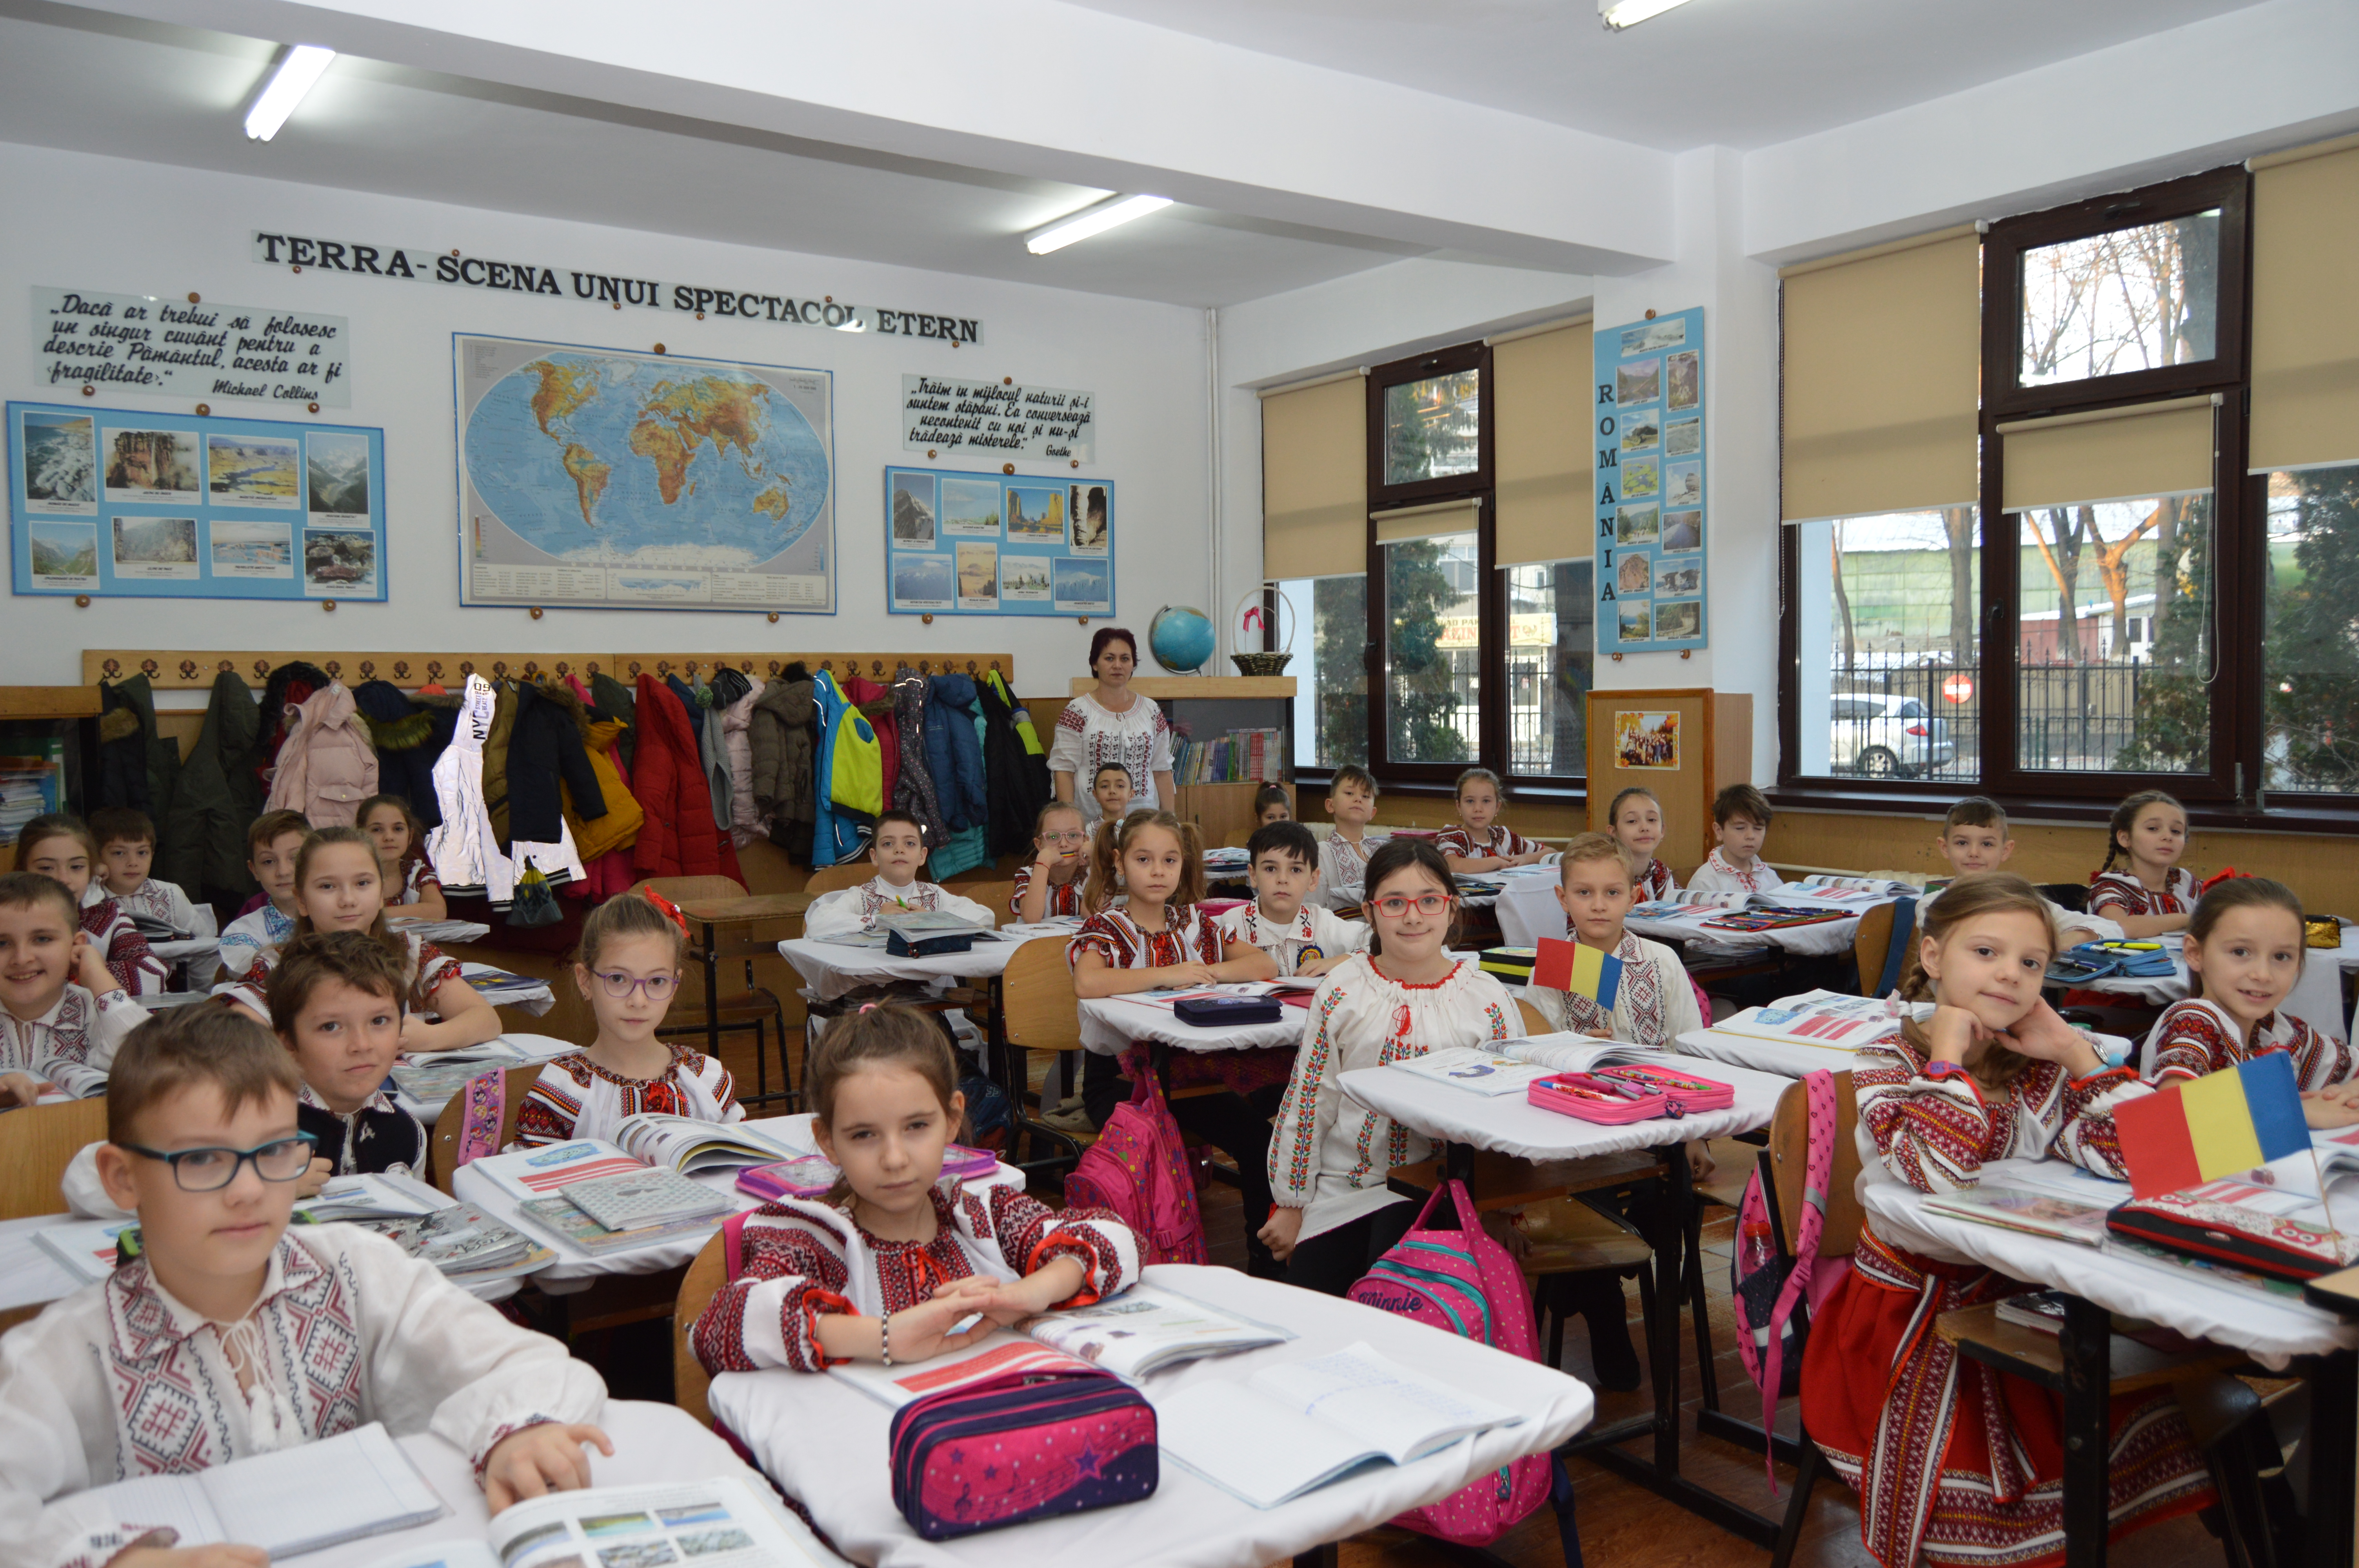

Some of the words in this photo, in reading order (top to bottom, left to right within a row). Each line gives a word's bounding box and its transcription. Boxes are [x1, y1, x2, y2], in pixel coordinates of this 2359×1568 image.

[436, 256, 562, 295] SCENA
[571, 272, 660, 307] UNUI
[674, 286, 862, 327] SPECTACOL
[877, 309, 978, 343] ETERN
[124, 307, 147, 320] ar
[160, 305, 219, 327] trebui
[264, 316, 336, 338] folosesc
[52, 321, 78, 334] un
[89, 321, 151, 345] singur
[164, 330, 228, 347] cuvânt
[236, 335, 295, 355] pentru
[309, 344, 320, 356] a
[43, 334, 113, 358] descrie
[233, 356, 289, 373] acesta
[297, 362, 318, 375] ar
[325, 362, 342, 384] fi
[212, 379, 267, 396] Michael
[273, 385, 318, 400] Collins
[956, 385, 968, 397] în
[972, 385, 1021, 403] mijlocul
[1025, 391, 1066, 406] naturii
[907, 396, 949, 410] suntem
[1005, 401, 1020, 417] Ea
[920, 415, 981, 430] necontenit
[988, 422, 1001, 431] cu
[1007, 422, 1026, 433] noi
[1046, 445, 1071, 457] Goethe
[1436, 627, 1477, 640] AZIN
[474, 682, 490, 691] 09
[1359, 1292, 1423, 1311] Minnie
